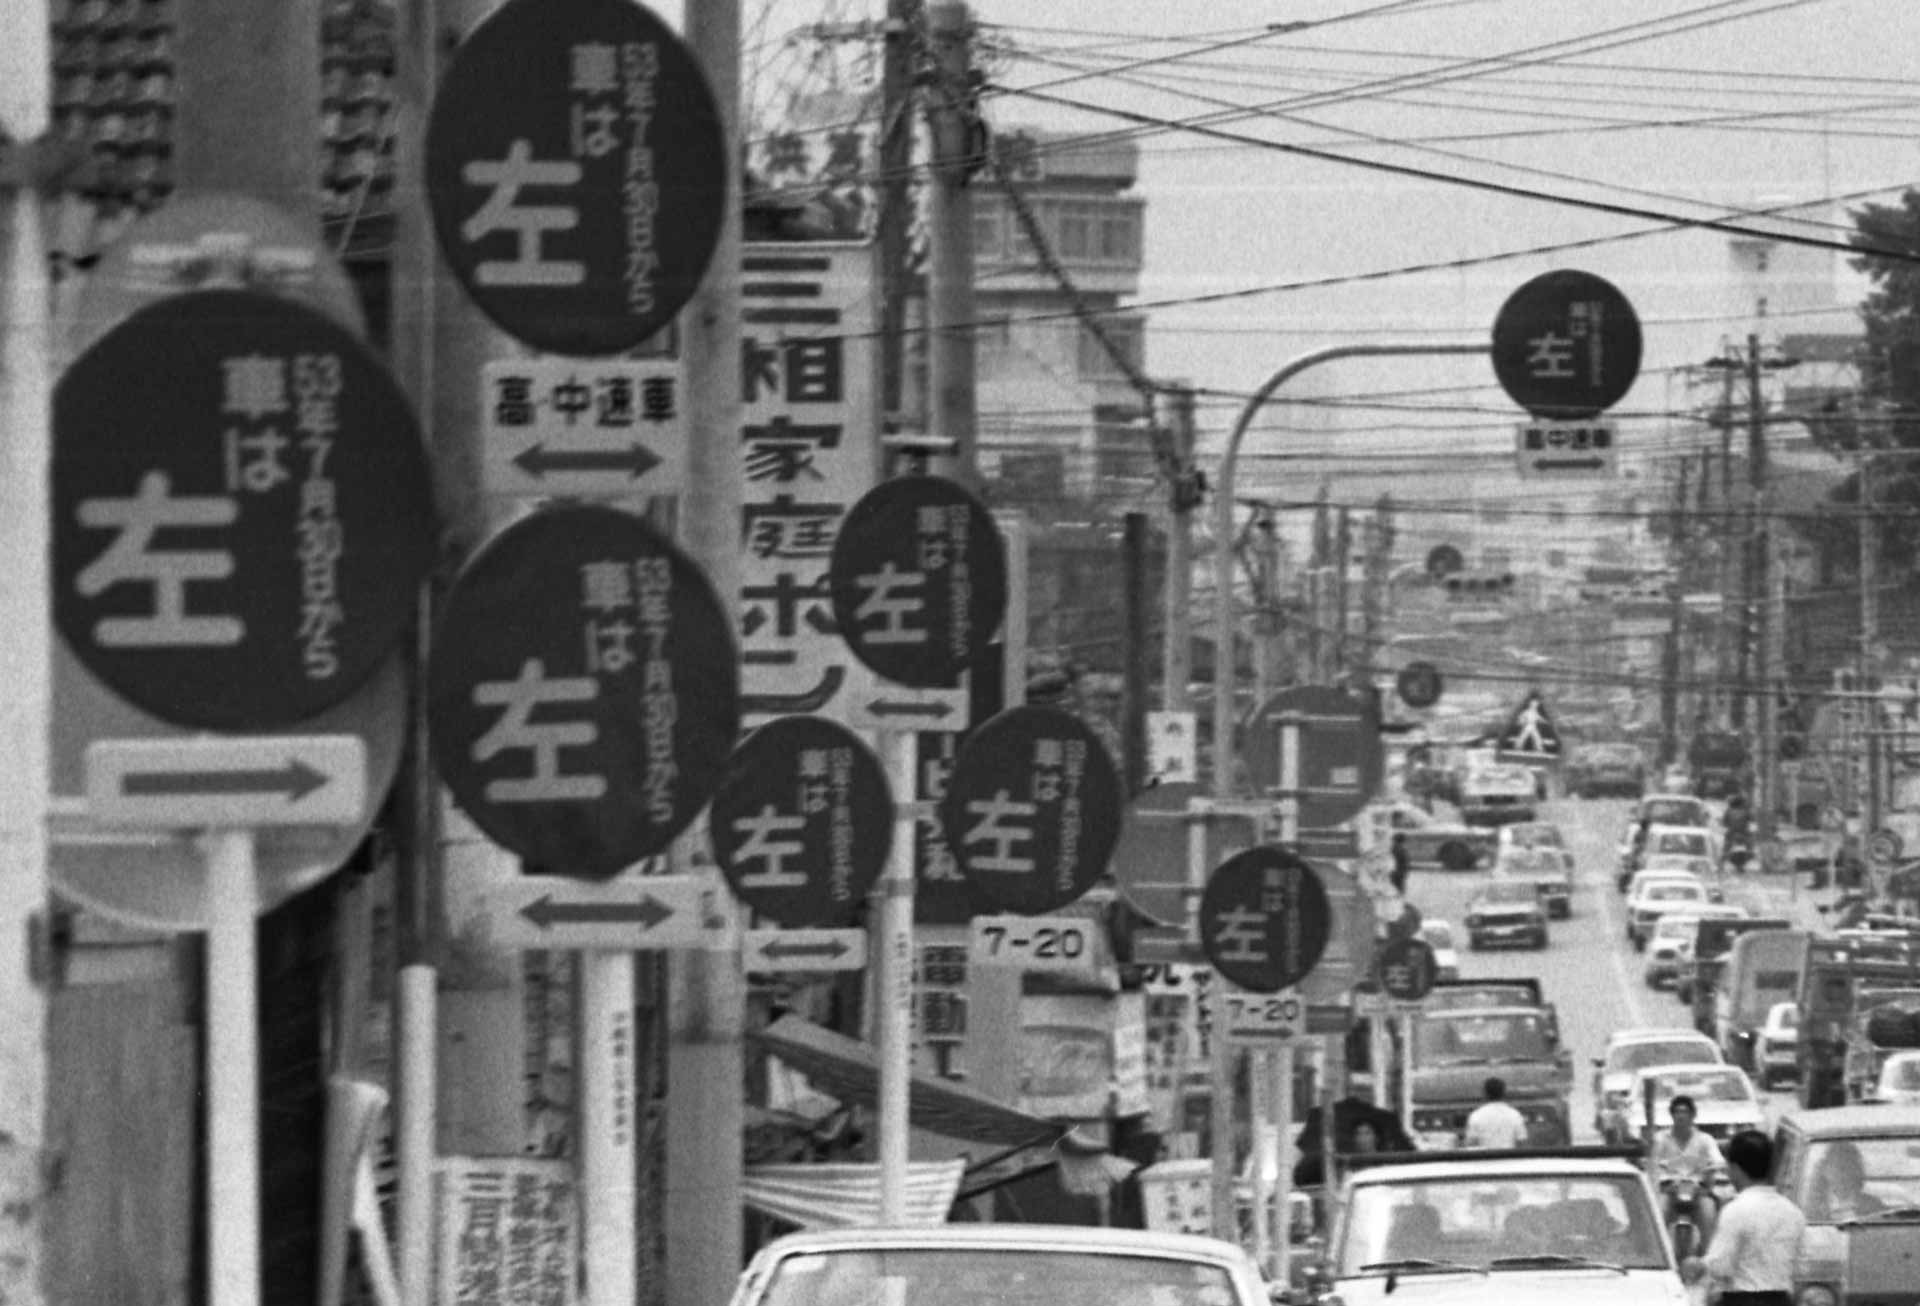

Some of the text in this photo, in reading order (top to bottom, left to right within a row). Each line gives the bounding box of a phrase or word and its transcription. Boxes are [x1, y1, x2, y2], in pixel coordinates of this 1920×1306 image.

[571, 42, 621, 157] 車は
[460, 139, 588, 288] 左
[621, 42, 660, 314] 53年7月30日から
[1528, 330, 1576, 377] 左
[221, 353, 290, 493] 車は
[76, 470, 245, 648] 左
[293, 354, 344, 680] 53年7月30日から
[581, 560, 637, 673] 車は
[855, 560, 928, 645] 左
[472, 658, 607, 803] 左
[637, 556, 680, 825] 53年7月30日から
[731, 804, 810, 888] 左
[962, 788, 1037, 873] 左
[982, 926, 1084, 960] 7-20
[1214, 903, 1268, 963] 左
[1227, 998, 1300, 1022] 7-20
